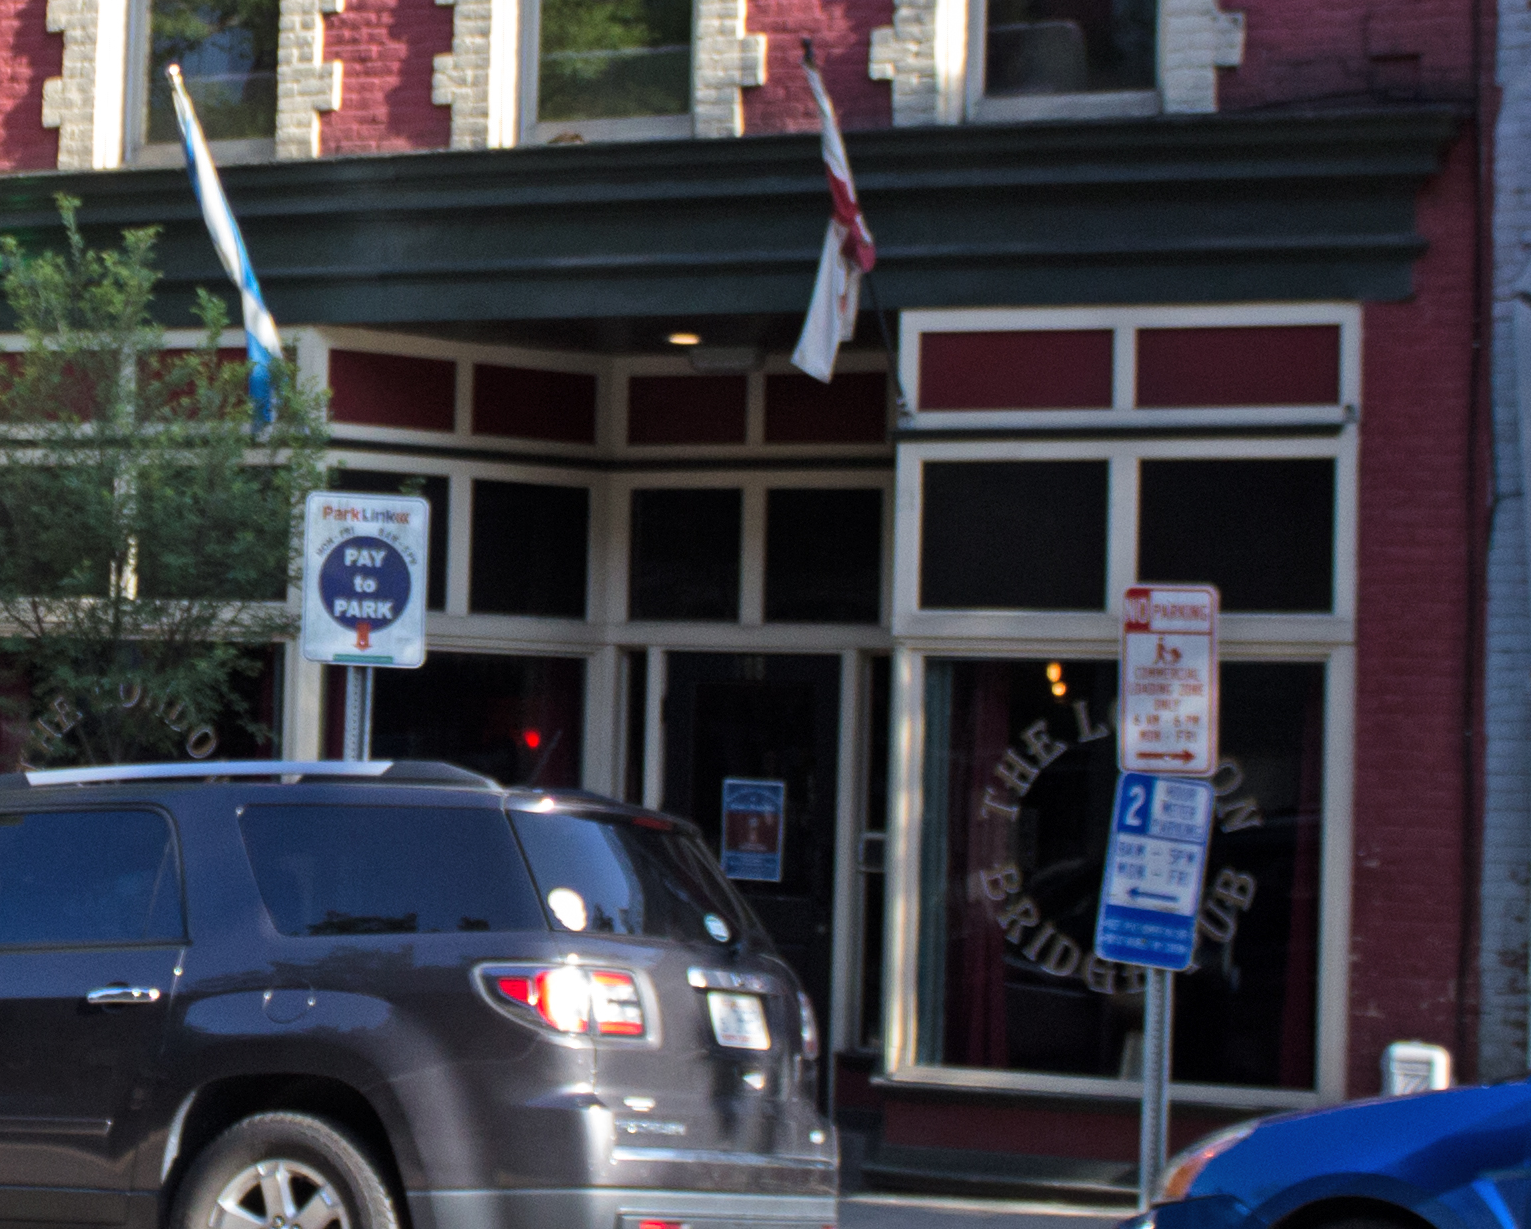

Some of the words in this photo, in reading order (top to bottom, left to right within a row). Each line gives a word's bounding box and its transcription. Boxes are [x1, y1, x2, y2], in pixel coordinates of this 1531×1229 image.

[343, 548, 388, 569] PAY
[353, 574, 378, 593] to
[332, 599, 394, 620] PARK
[1125, 597, 1149, 624] NO
[1153, 603, 1209, 622] PARKING
[1175, 729, 1197, 743] FRI
[980, 717, 1068, 821] THE
[1123, 783, 1147, 827] 2
